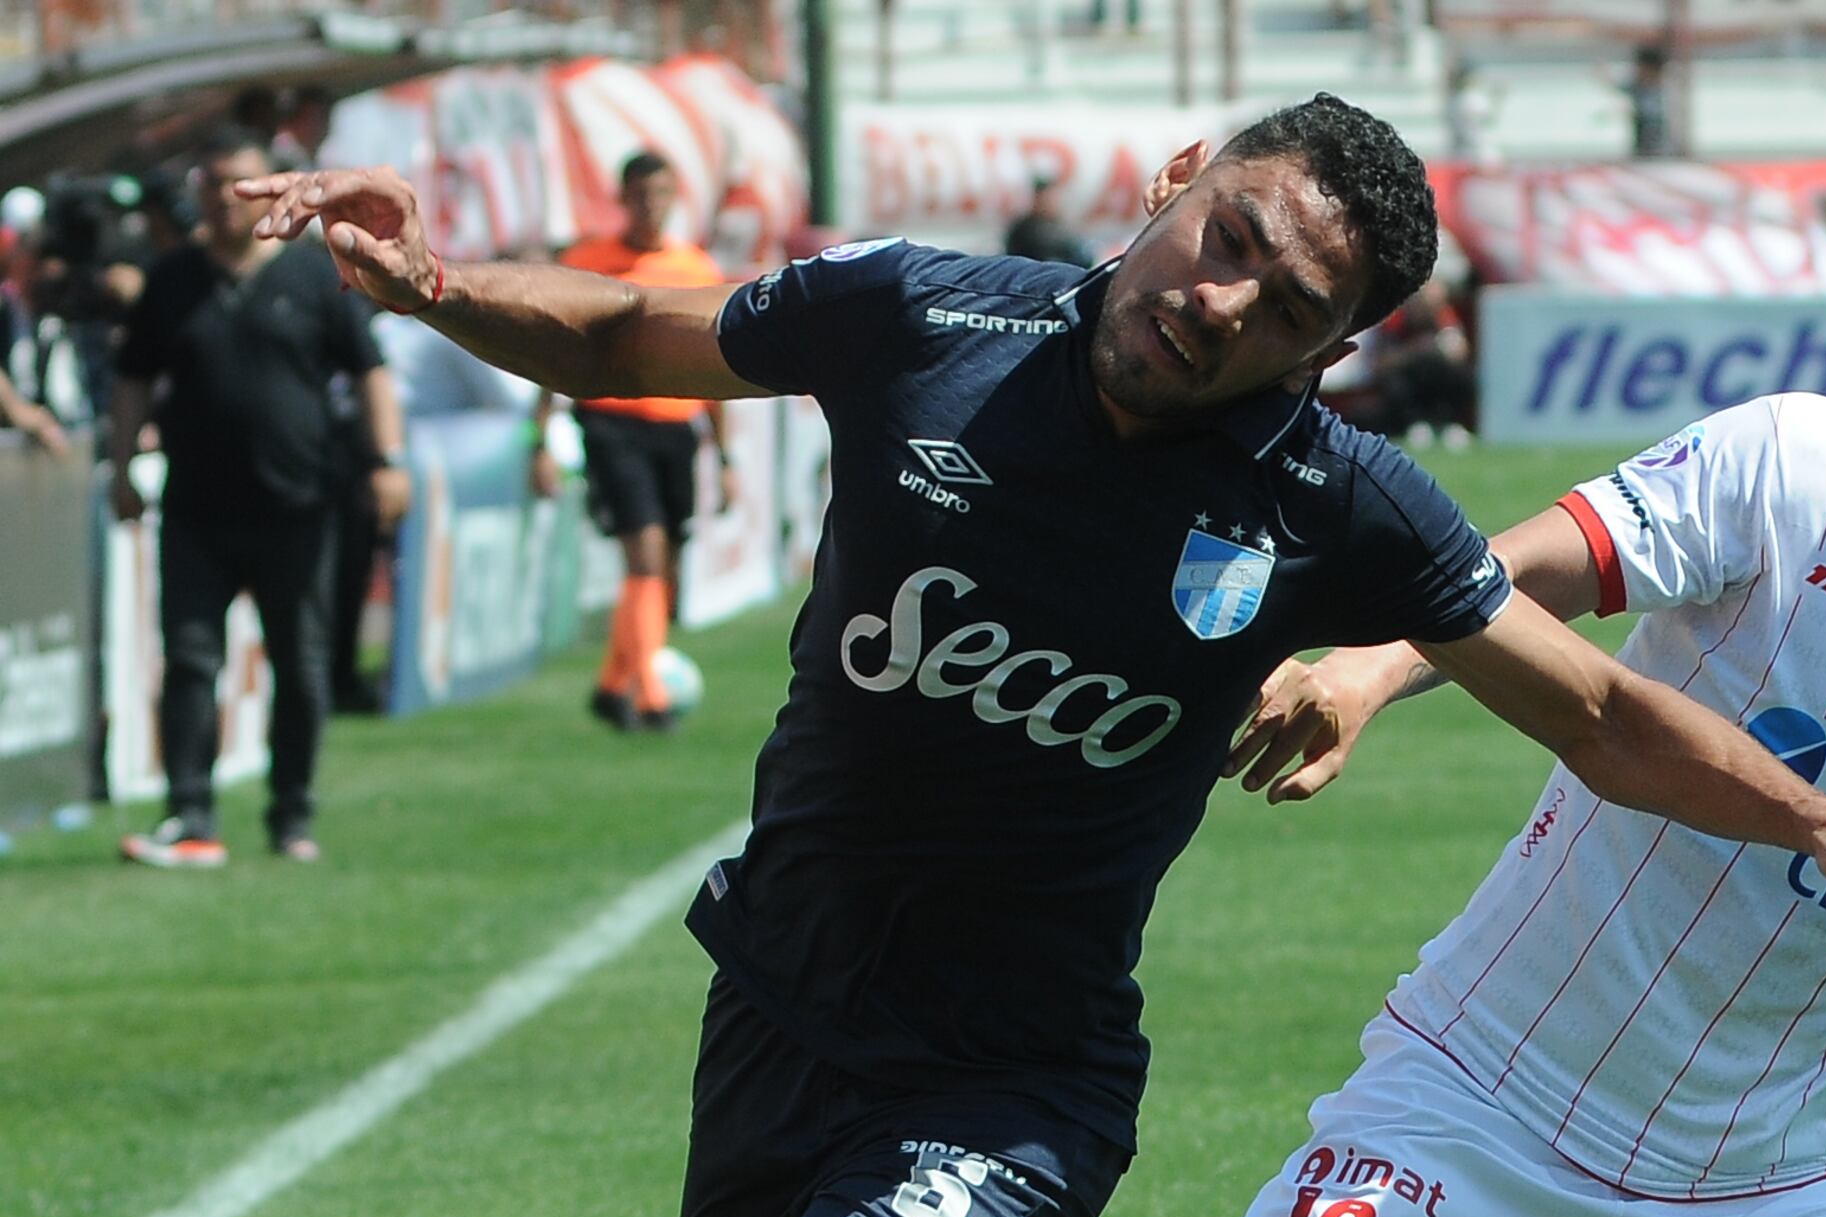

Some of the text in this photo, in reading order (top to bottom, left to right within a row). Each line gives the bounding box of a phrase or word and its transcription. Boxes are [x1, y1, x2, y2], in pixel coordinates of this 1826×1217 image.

[925, 307, 1070, 335] SPORTING
[898, 469, 971, 513] umbro
[841, 566, 1182, 768] Secco
